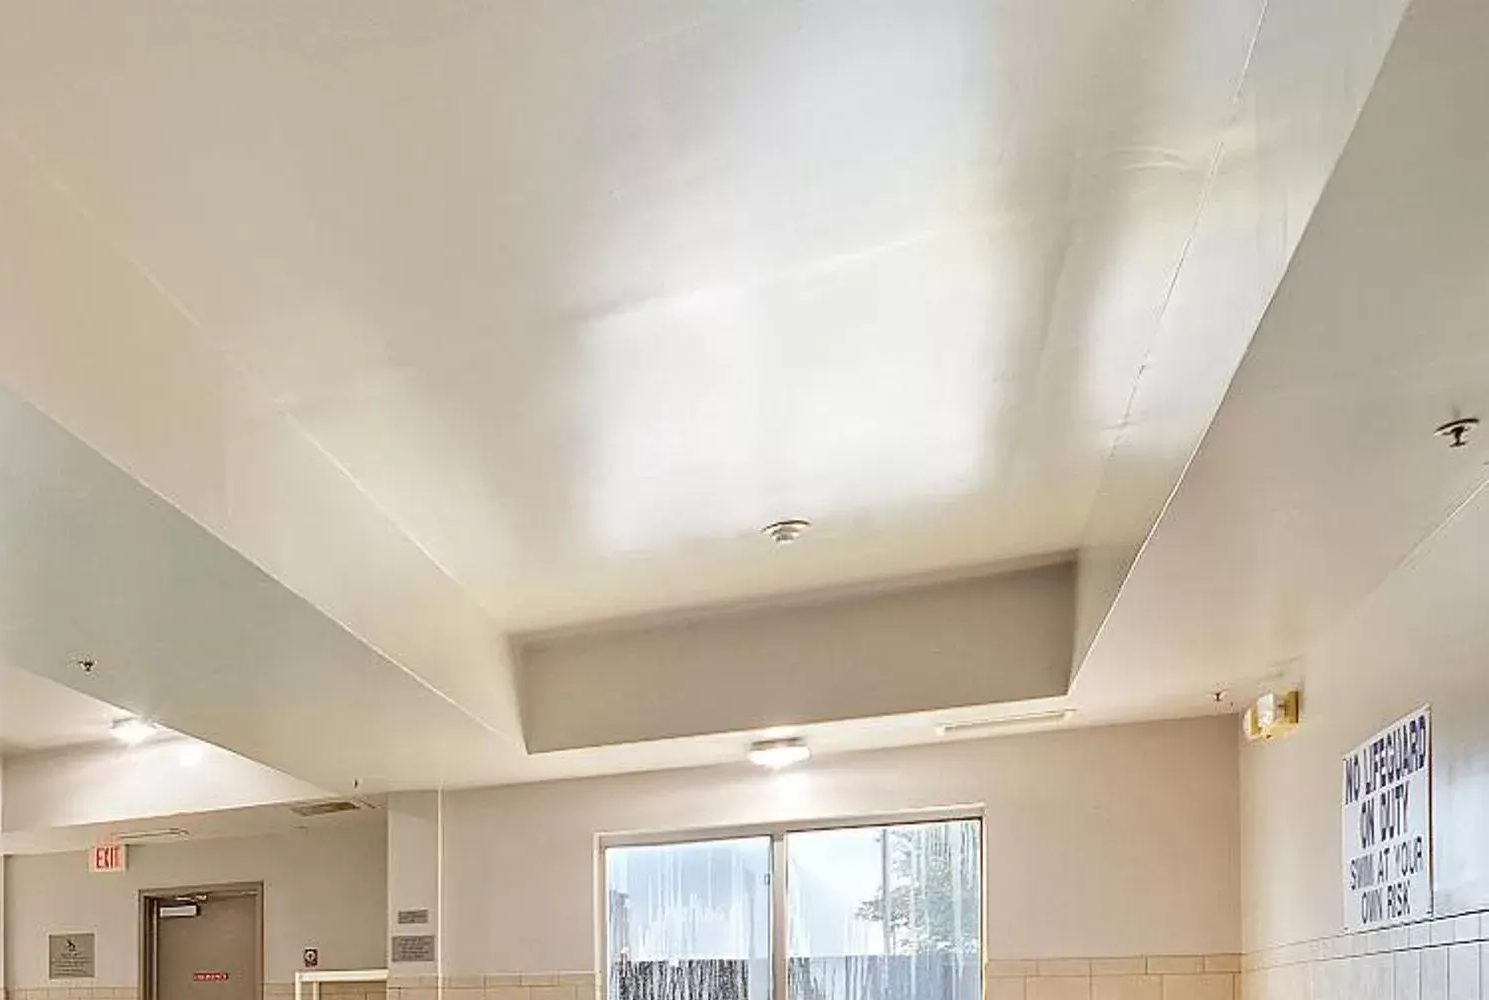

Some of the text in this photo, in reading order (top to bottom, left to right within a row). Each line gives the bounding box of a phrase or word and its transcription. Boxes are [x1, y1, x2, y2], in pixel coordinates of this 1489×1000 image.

[1346, 714, 1426, 804] NO LIFEGUARD
[1361, 781, 1409, 848] ON DUTY
[96, 847, 118, 868] EXIT
[1377, 847, 1390, 884] AT
[1387, 879, 1411, 919] RISK
